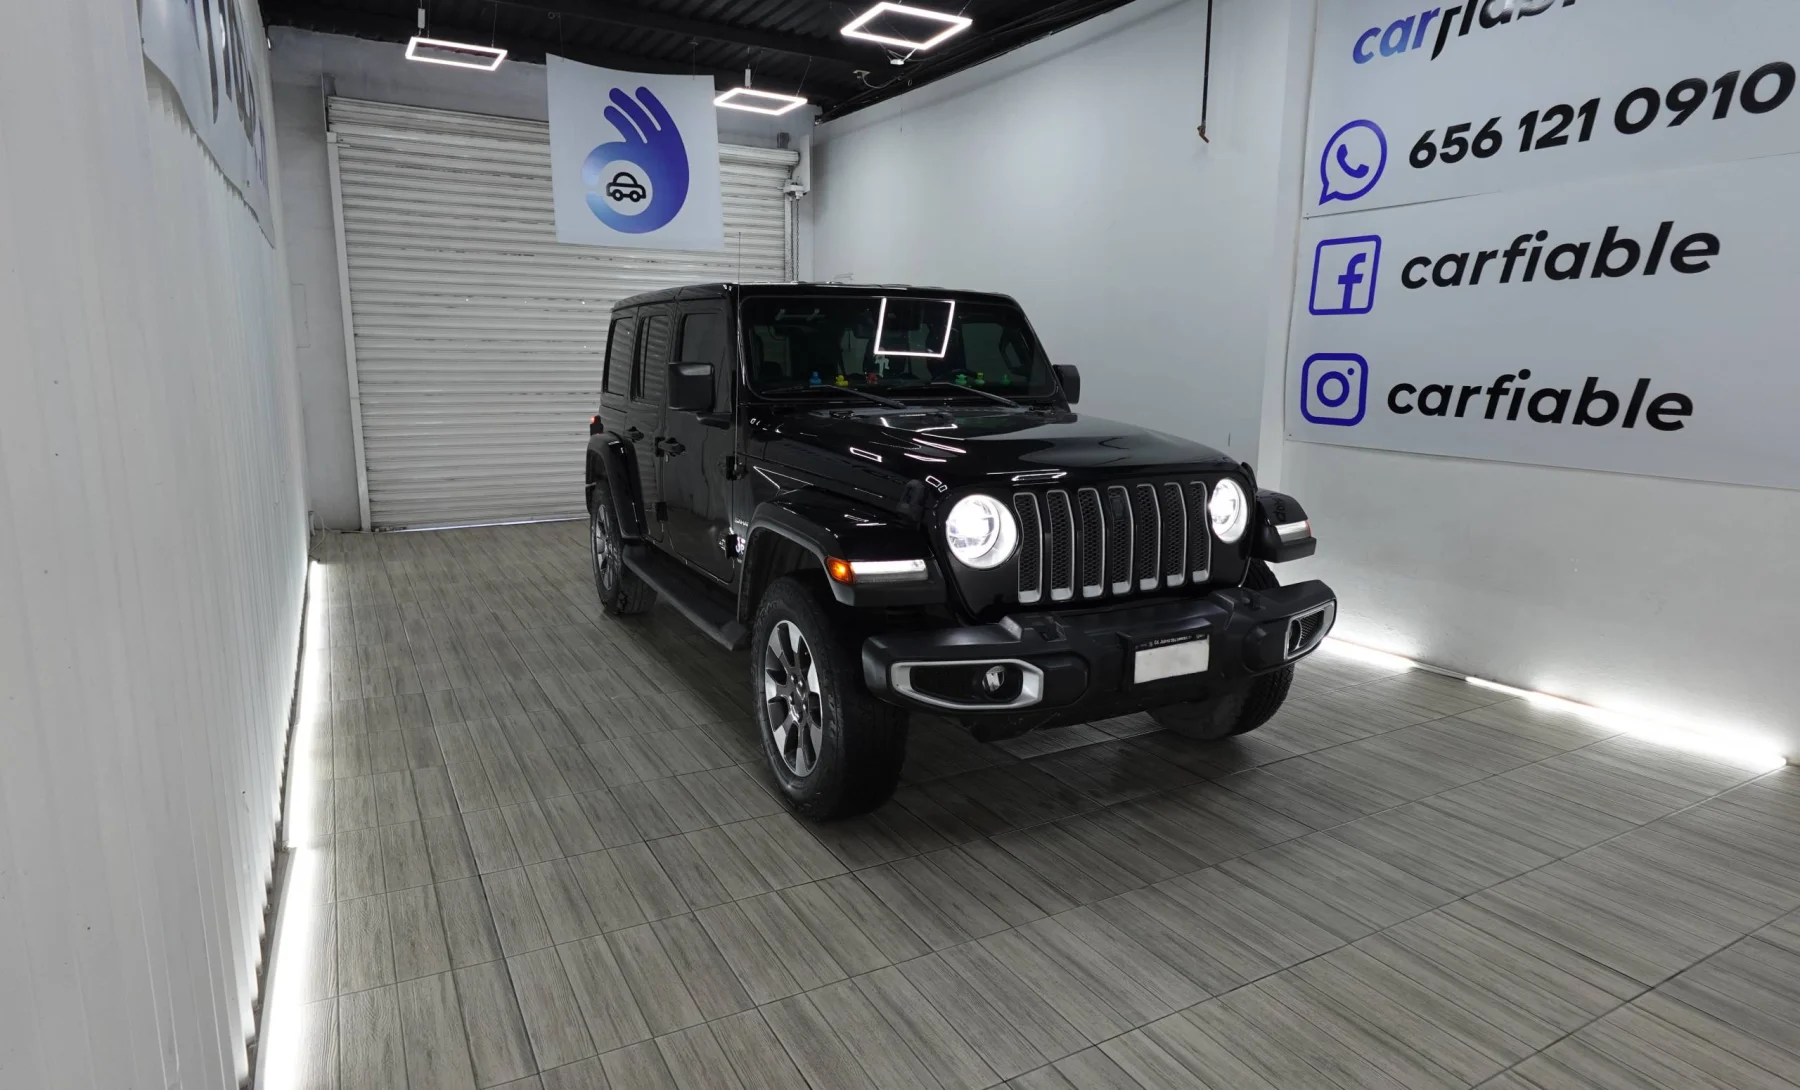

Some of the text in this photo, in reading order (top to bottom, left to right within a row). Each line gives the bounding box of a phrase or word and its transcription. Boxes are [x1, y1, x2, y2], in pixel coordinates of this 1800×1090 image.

[1409, 62, 1795, 168] 656 121 0910
[1402, 221, 1720, 289] carfiable
[1388, 369, 1693, 431] carfiable
